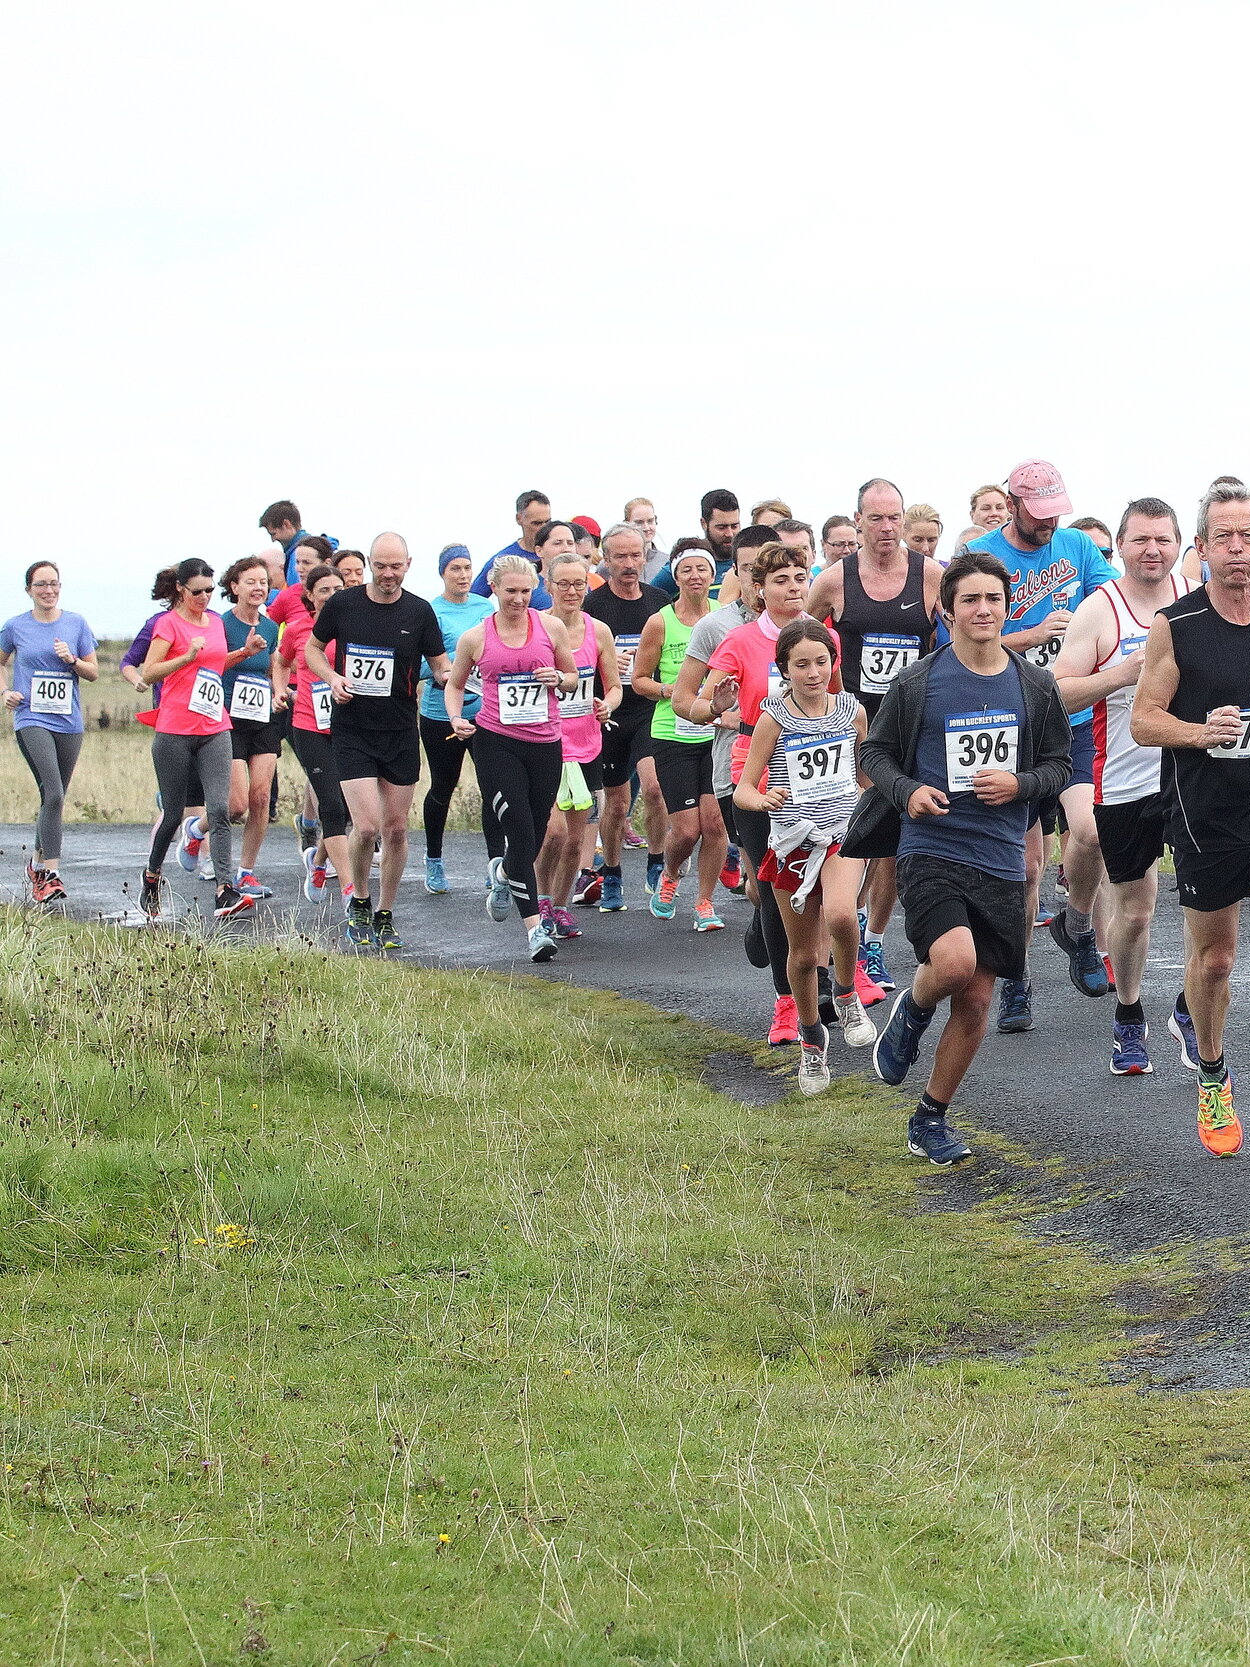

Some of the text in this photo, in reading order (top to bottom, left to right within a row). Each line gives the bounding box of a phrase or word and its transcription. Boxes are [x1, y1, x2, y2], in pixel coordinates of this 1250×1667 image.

[870, 649, 908, 675] 371
[1035, 637, 1065, 667] 39
[352, 658, 386, 681] 376
[37, 681, 66, 700] 408
[198, 682, 220, 705] 405
[238, 686, 264, 707] 420
[506, 684, 543, 707] 377
[949, 713, 1017, 728] JOHN BUCKLEY SPORTS
[787, 738, 802, 747] JOHN
[802, 733, 826, 744] BUCKLEY
[958, 731, 1009, 767] 396
[797, 744, 842, 780] 397
